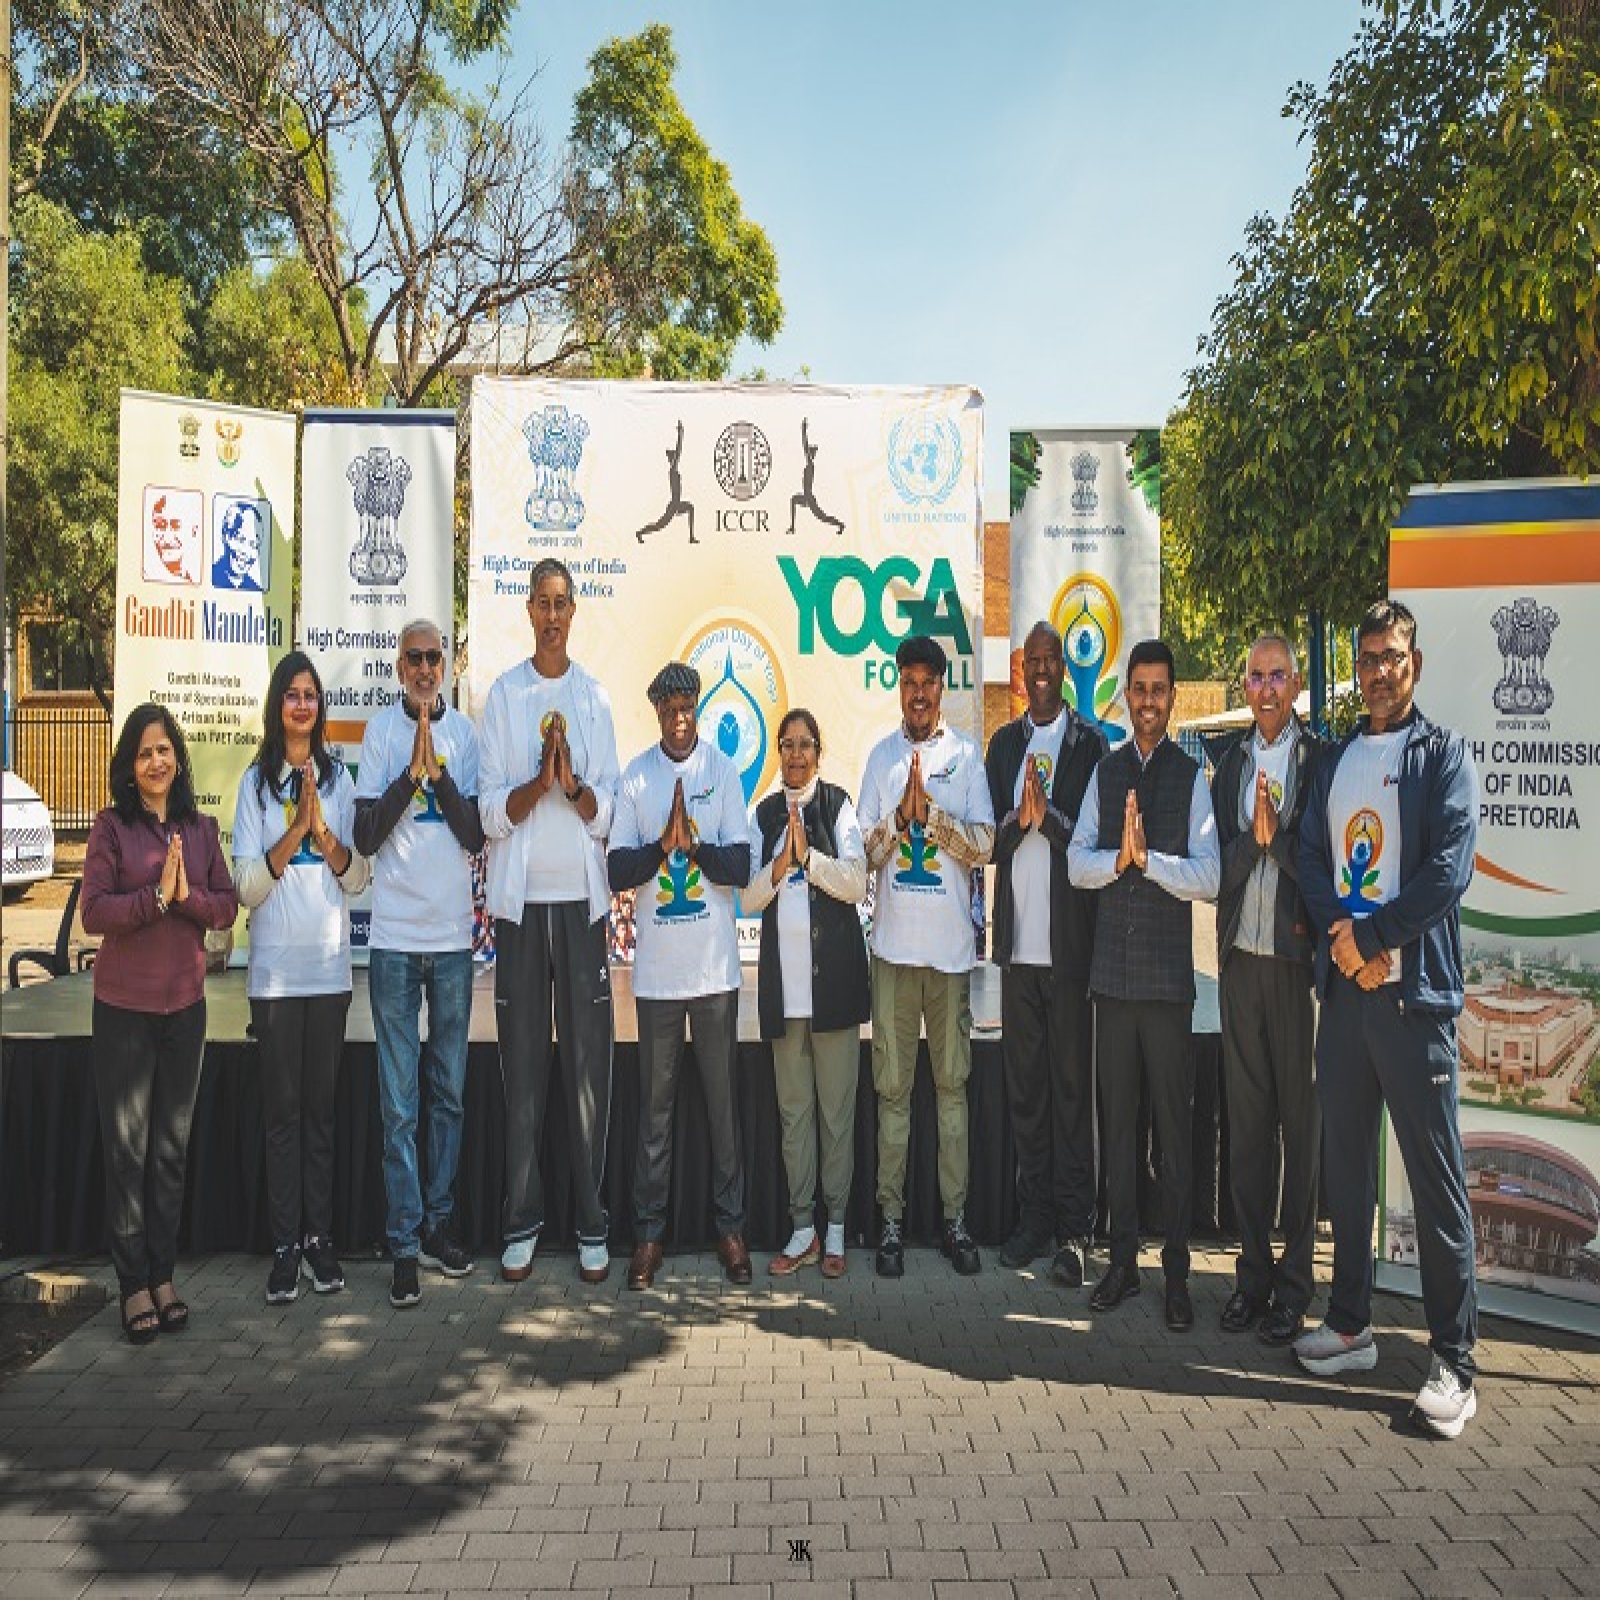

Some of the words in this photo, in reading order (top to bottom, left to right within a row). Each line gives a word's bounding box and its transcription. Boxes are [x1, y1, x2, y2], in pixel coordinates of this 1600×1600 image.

[715, 510, 770, 532] ICCR
[482, 554, 511, 575] High
[511, 556, 581, 573] Comion
[583, 558, 596, 574] of
[596, 557, 627, 574] India
[579, 579, 614, 597] Africa
[775, 555, 974, 657] YOGA
[125, 594, 195, 640] Gandhi
[202, 600, 283, 646] Mandela
[307, 627, 333, 651] High
[335, 627, 400, 649] Commissio
[167, 669, 201, 685] Gandhi
[202, 671, 241, 688] Mandela
[362, 657, 373, 677] in
[375, 658, 393, 678] the
[863, 660, 899, 691] FO
[947, 660, 974, 691] LL
[326, 686, 360, 709] public
[361, 687, 374, 706] of
[1485, 772, 1512, 796] OF
[1517, 774, 1573, 797] INDIA
[1479, 804, 1581, 830] PRETORIA
